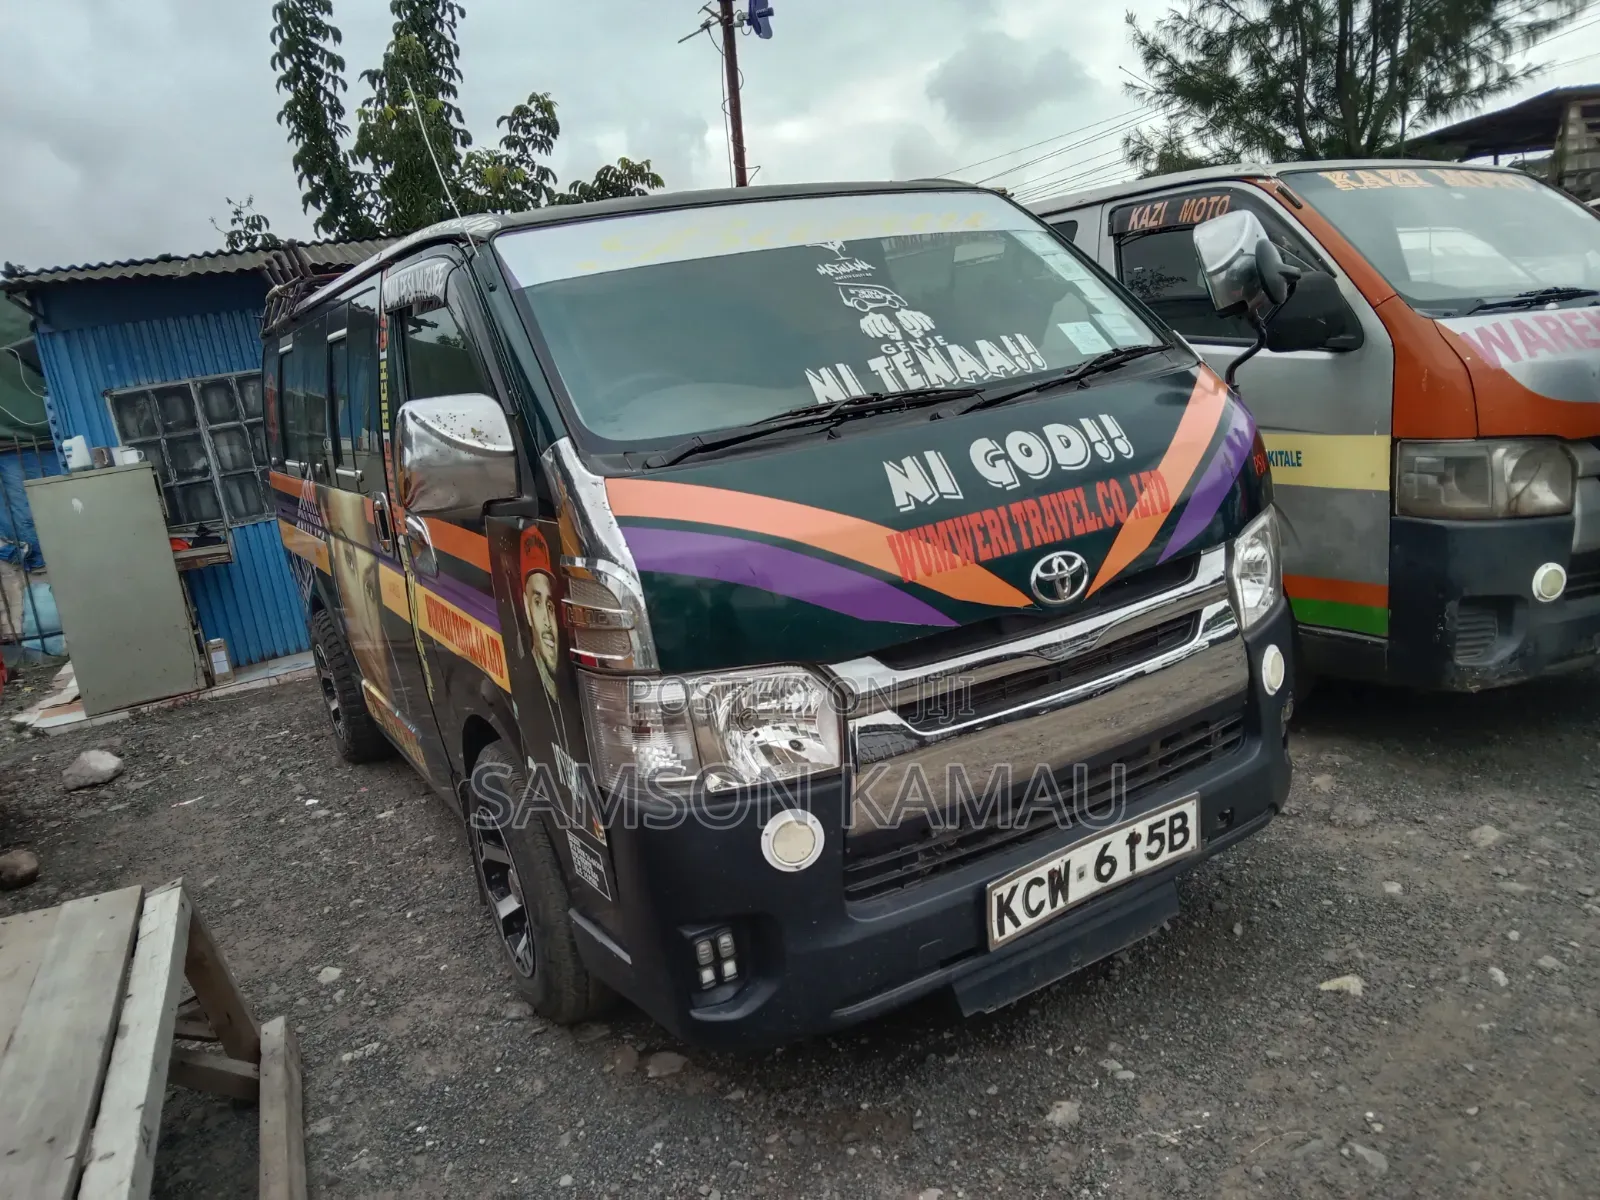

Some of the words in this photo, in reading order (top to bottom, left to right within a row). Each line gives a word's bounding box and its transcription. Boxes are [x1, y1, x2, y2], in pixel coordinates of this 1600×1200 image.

[1128, 201, 1169, 231] KAZI
[1178, 195, 1231, 223] MOTO
[804, 362, 867, 405] NI
[867, 333, 1048, 394] TENAA!!
[880, 335, 949, 355] GENJE
[882, 449, 964, 513] NI
[969, 413, 1135, 491] GOD!!
[1267, 450, 1303, 467] KITALE
[885, 505, 1017, 583] WUMWERI
[995, 858, 1072, 937] KCW
[1093, 810, 1191, 885] 615B
